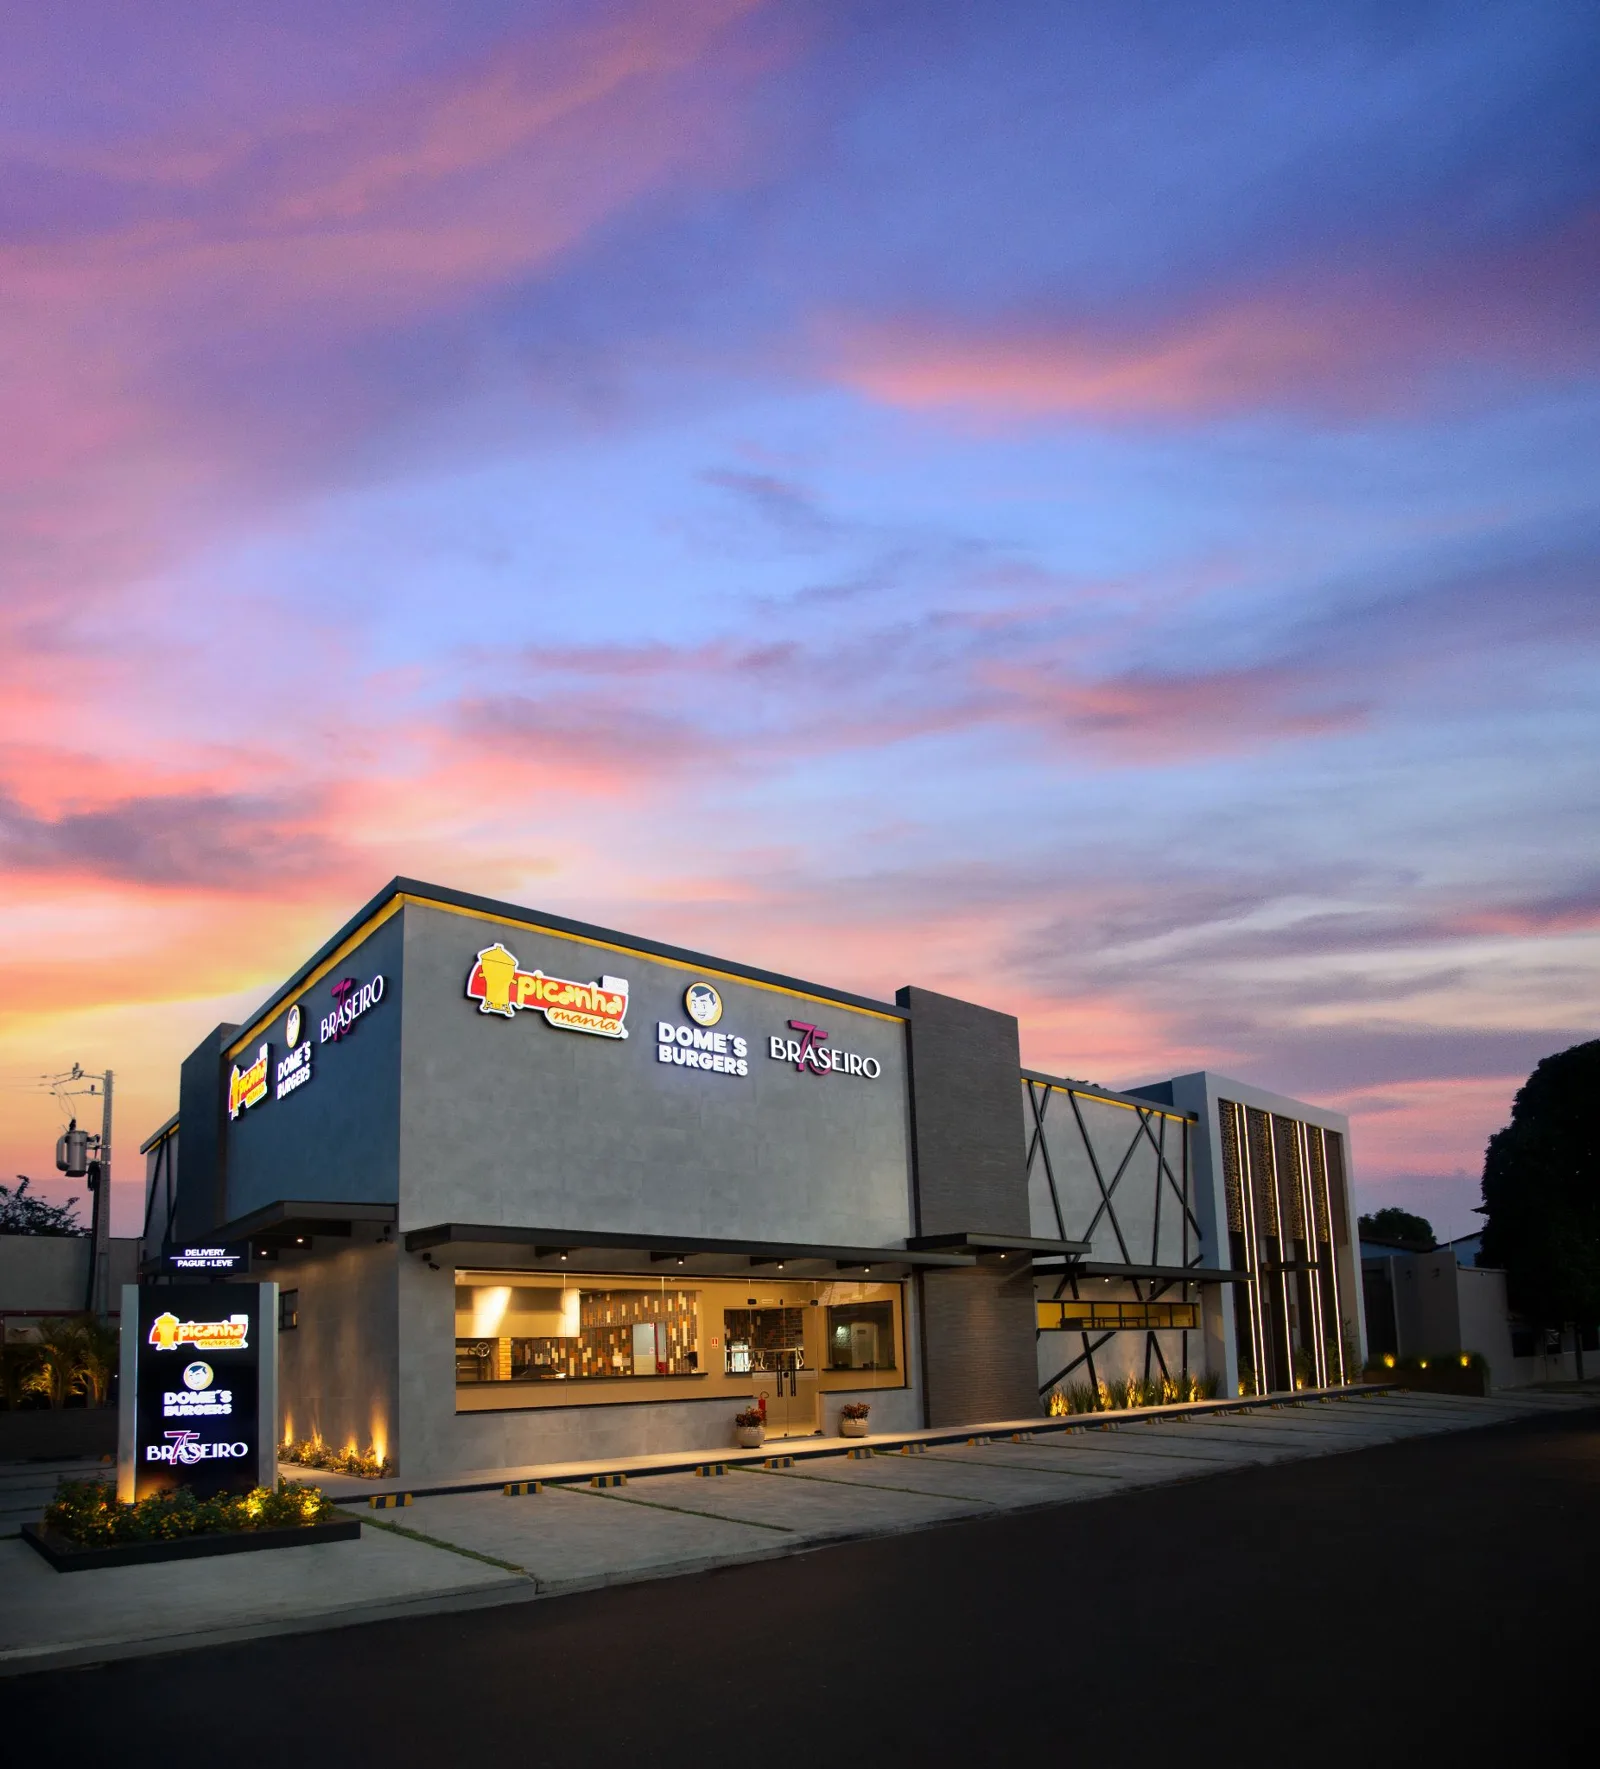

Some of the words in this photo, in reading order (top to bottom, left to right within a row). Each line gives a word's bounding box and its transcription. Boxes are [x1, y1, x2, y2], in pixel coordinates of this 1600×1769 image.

[517, 971, 623, 1015] picanha
[320, 974, 384, 1043] BRASEIRO
[553, 1011, 618, 1031] mania
[657, 1045, 748, 1077] BURGERS
[769, 1036, 881, 1079] BRASEIRO
[277, 1063, 311, 1100] BURGERS
[177, 1259, 206, 1267] PAGUE
[211, 1259, 233, 1267] LEVE
[184, 1248, 226, 1257] DELIVERY
[178, 1322, 244, 1344] picanha
[163, 1403, 232, 1417] BURGERS
[146, 1442, 248, 1461] BRASEIRO
